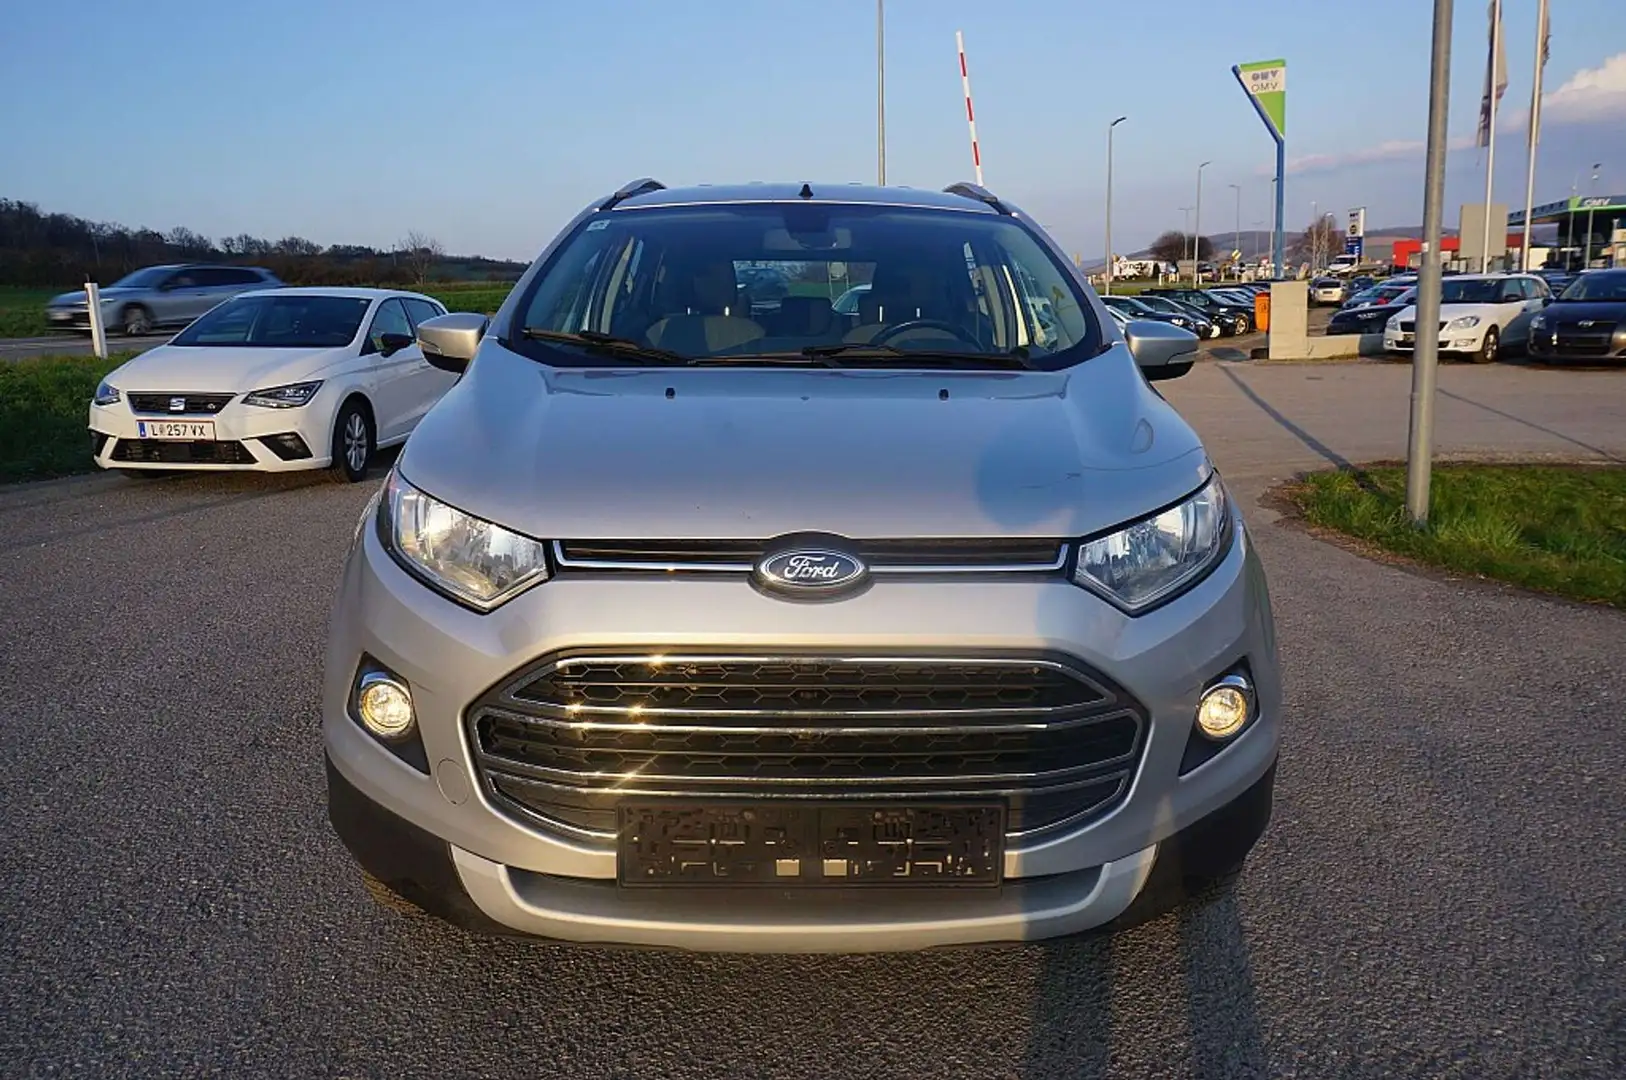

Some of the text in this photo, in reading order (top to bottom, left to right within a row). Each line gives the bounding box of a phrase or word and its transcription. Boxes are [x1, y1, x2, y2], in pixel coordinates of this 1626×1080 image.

[1251, 82, 1279, 92] OMV
[166, 424, 188, 436] 257
[190, 424, 206, 436] VX
[784, 555, 840, 578] Ford
